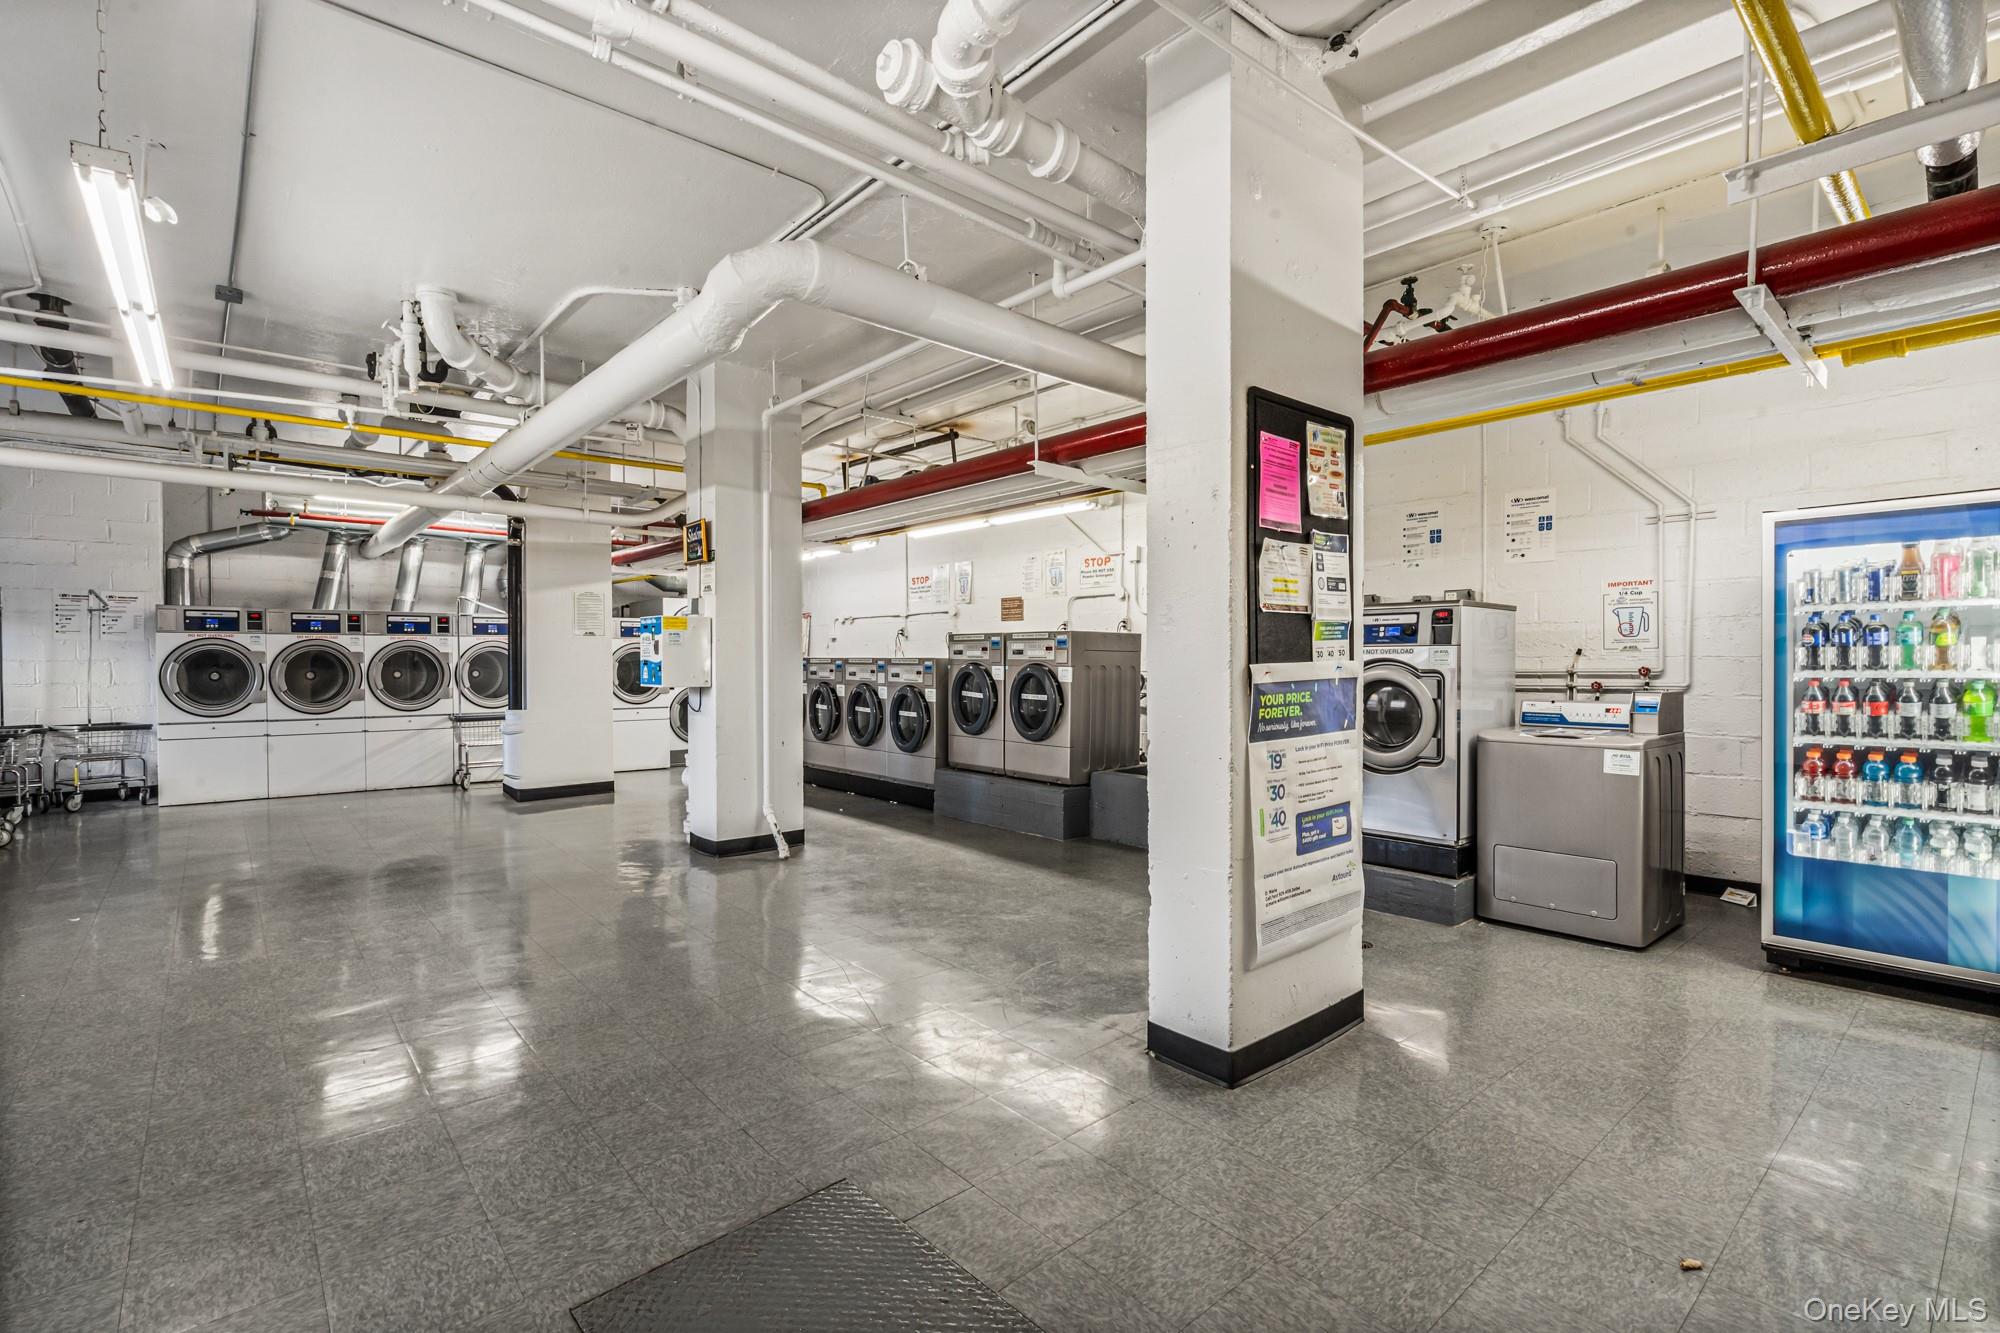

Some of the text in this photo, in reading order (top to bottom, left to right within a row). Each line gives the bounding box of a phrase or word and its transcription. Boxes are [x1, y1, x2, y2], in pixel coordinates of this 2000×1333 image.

[1084, 556, 1111, 567] STOP
[911, 576, 929, 585] STOP
[1607, 579, 1654, 588] IMPORTANT
[1260, 691, 1312, 706] YOUR PRICE.
[1259, 705, 1302, 719] FOREVER.
[1331, 871, 1352, 882] Astound
